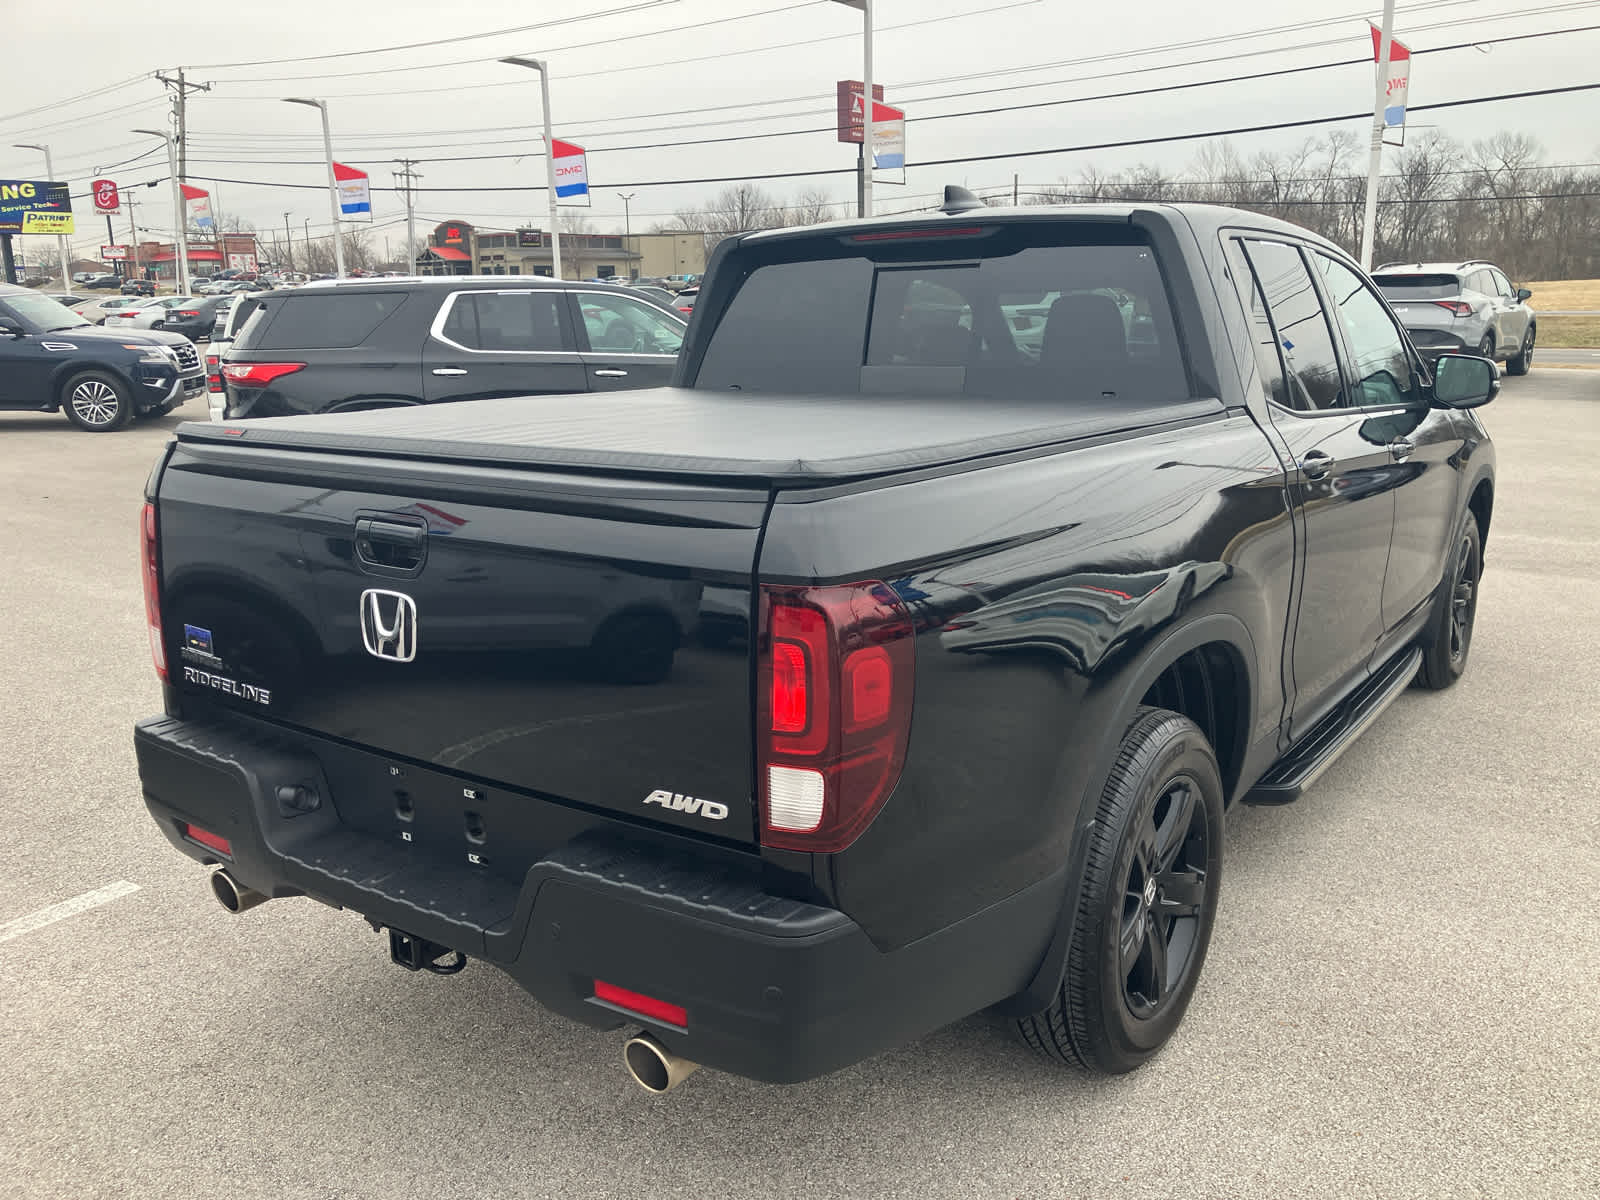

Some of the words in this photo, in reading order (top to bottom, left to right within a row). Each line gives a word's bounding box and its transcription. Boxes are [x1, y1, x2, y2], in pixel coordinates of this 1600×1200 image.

[0, 183, 36, 200] NG
[1, 204, 32, 213] Service
[27, 213, 72, 224] PATRIOT
[183, 666, 270, 705] RIDGELINE
[642, 789, 729, 820] AWD
